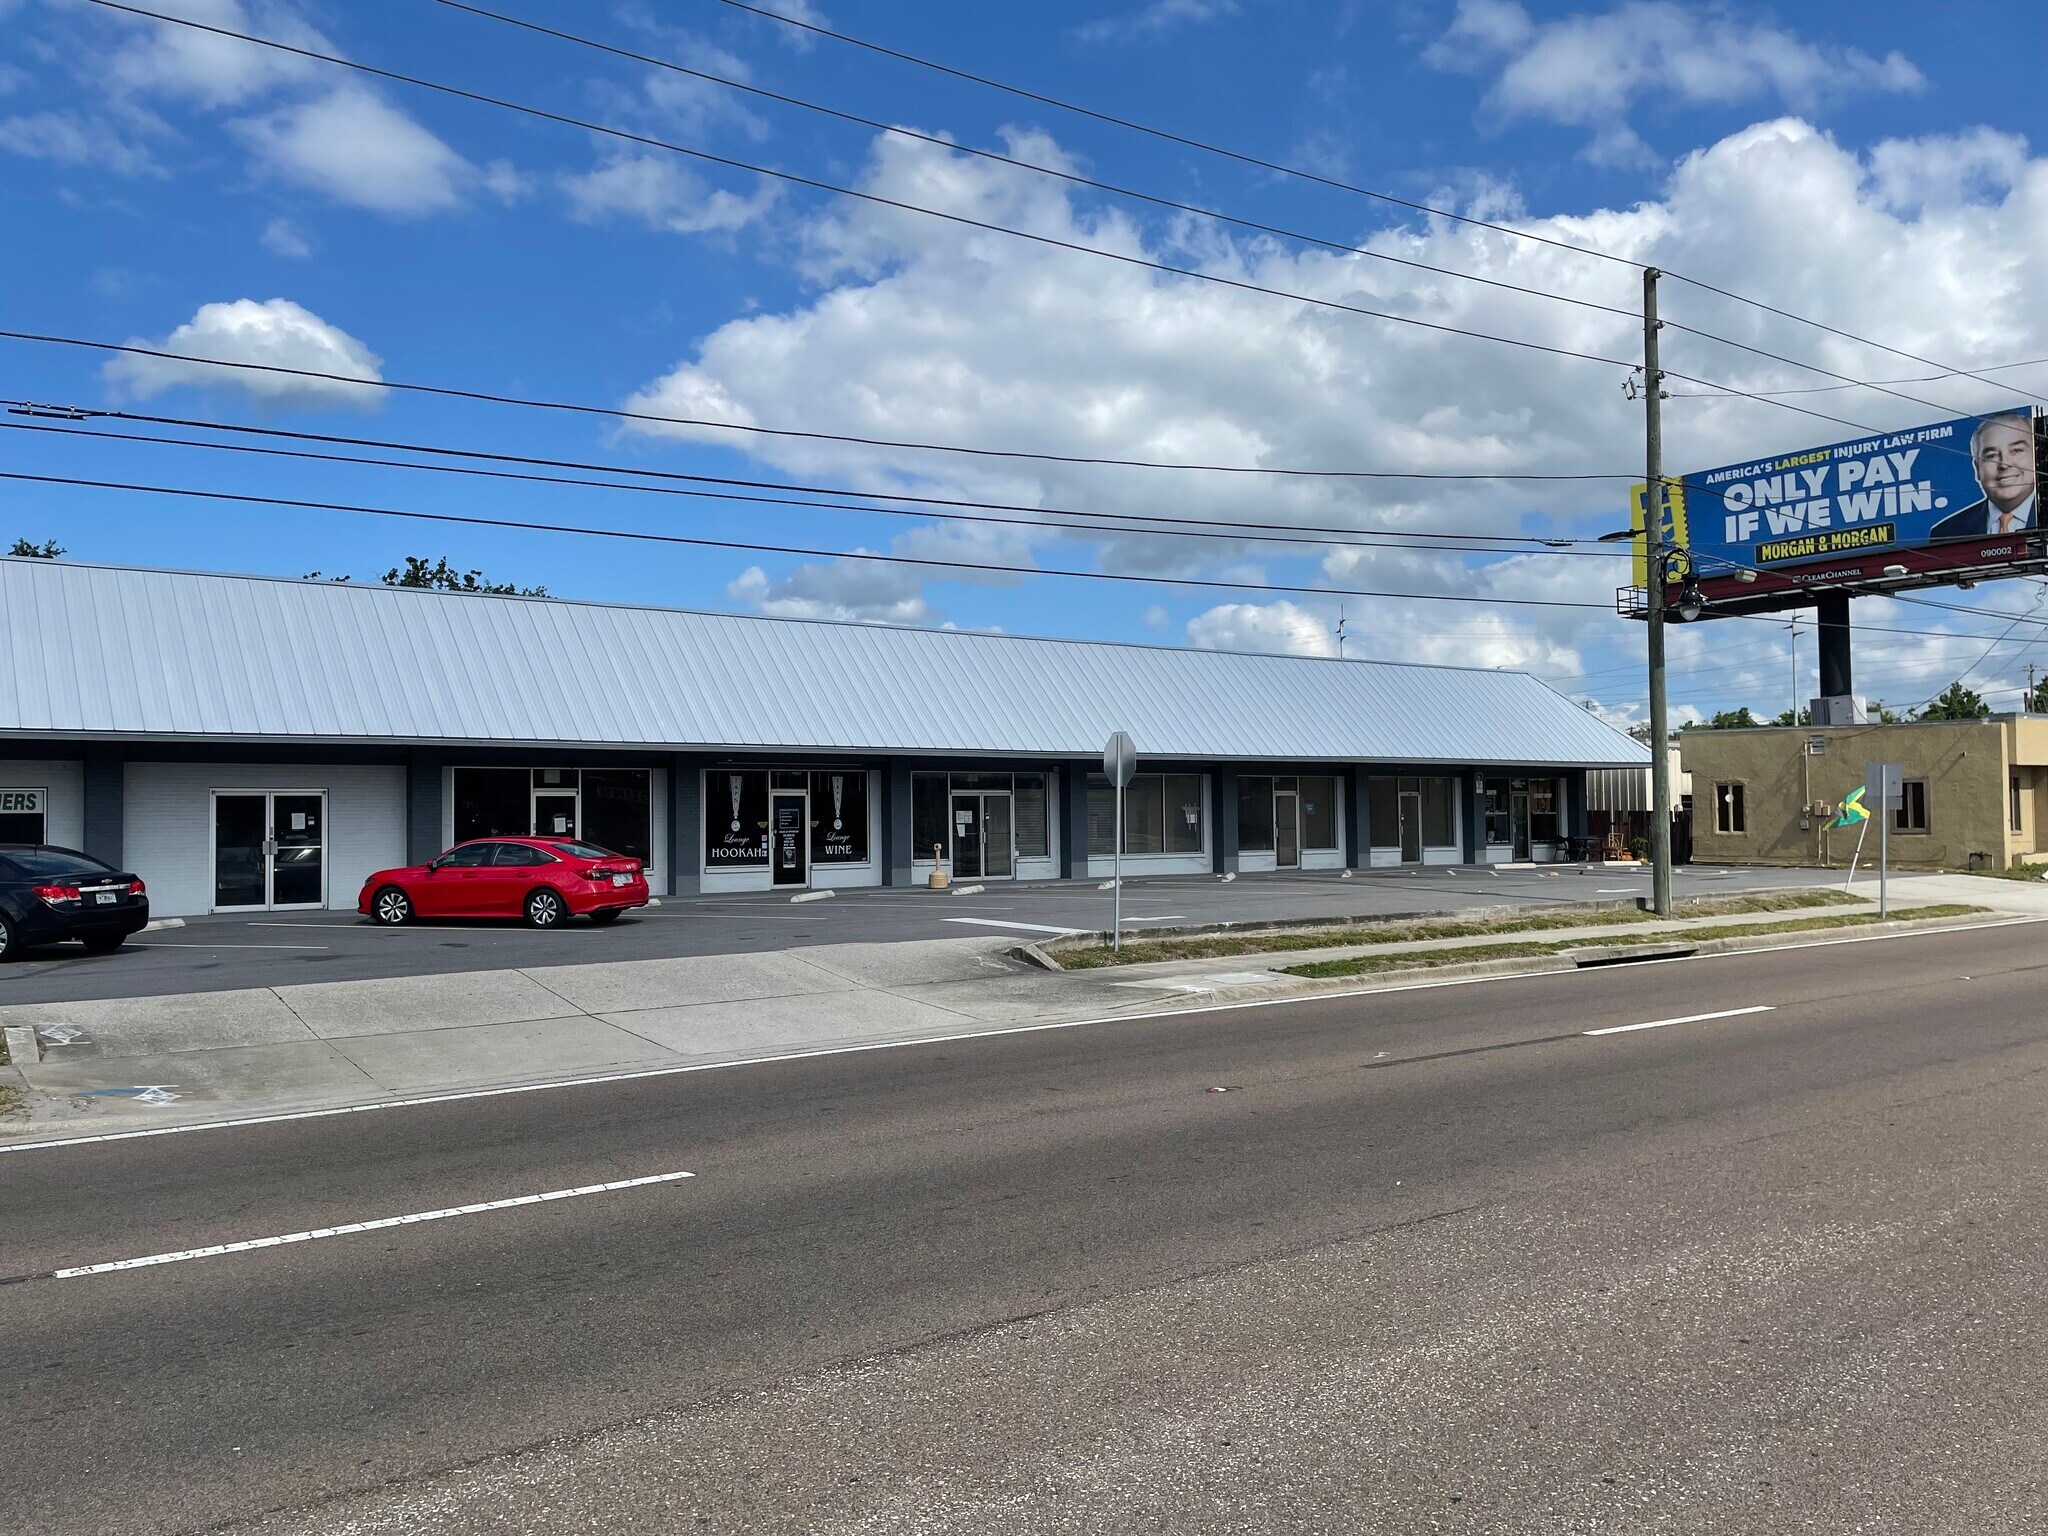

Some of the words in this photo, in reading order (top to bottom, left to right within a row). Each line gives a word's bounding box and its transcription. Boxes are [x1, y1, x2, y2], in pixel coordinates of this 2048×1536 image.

[1706, 462, 1772, 485] AMERICA'S
[1775, 450, 1831, 470] LARGEST
[1834, 440, 1881, 459] INJURY
[1883, 433, 1915, 449] LAW
[1917, 425, 1953, 443] FIRM
[1723, 465, 1830, 512] ONLY
[1838, 448, 1920, 492] PAY
[1725, 511, 1760, 544] IF
[1764, 498, 1831, 536] WE
[1837, 480, 1948, 523] WIN.
[1762, 537, 1815, 561] MORGAN
[1818, 535, 1828, 552] &
[1831, 526, 1888, 550] MORGAN
[1980, 546, 2012, 558] 090002
[0, 793, 37, 811] ERS
[723, 833, 750, 847] Lounge
[826, 831, 851, 844] Lounge
[711, 847, 762, 858] HOOKAH
[825, 845, 852, 855] WINE
